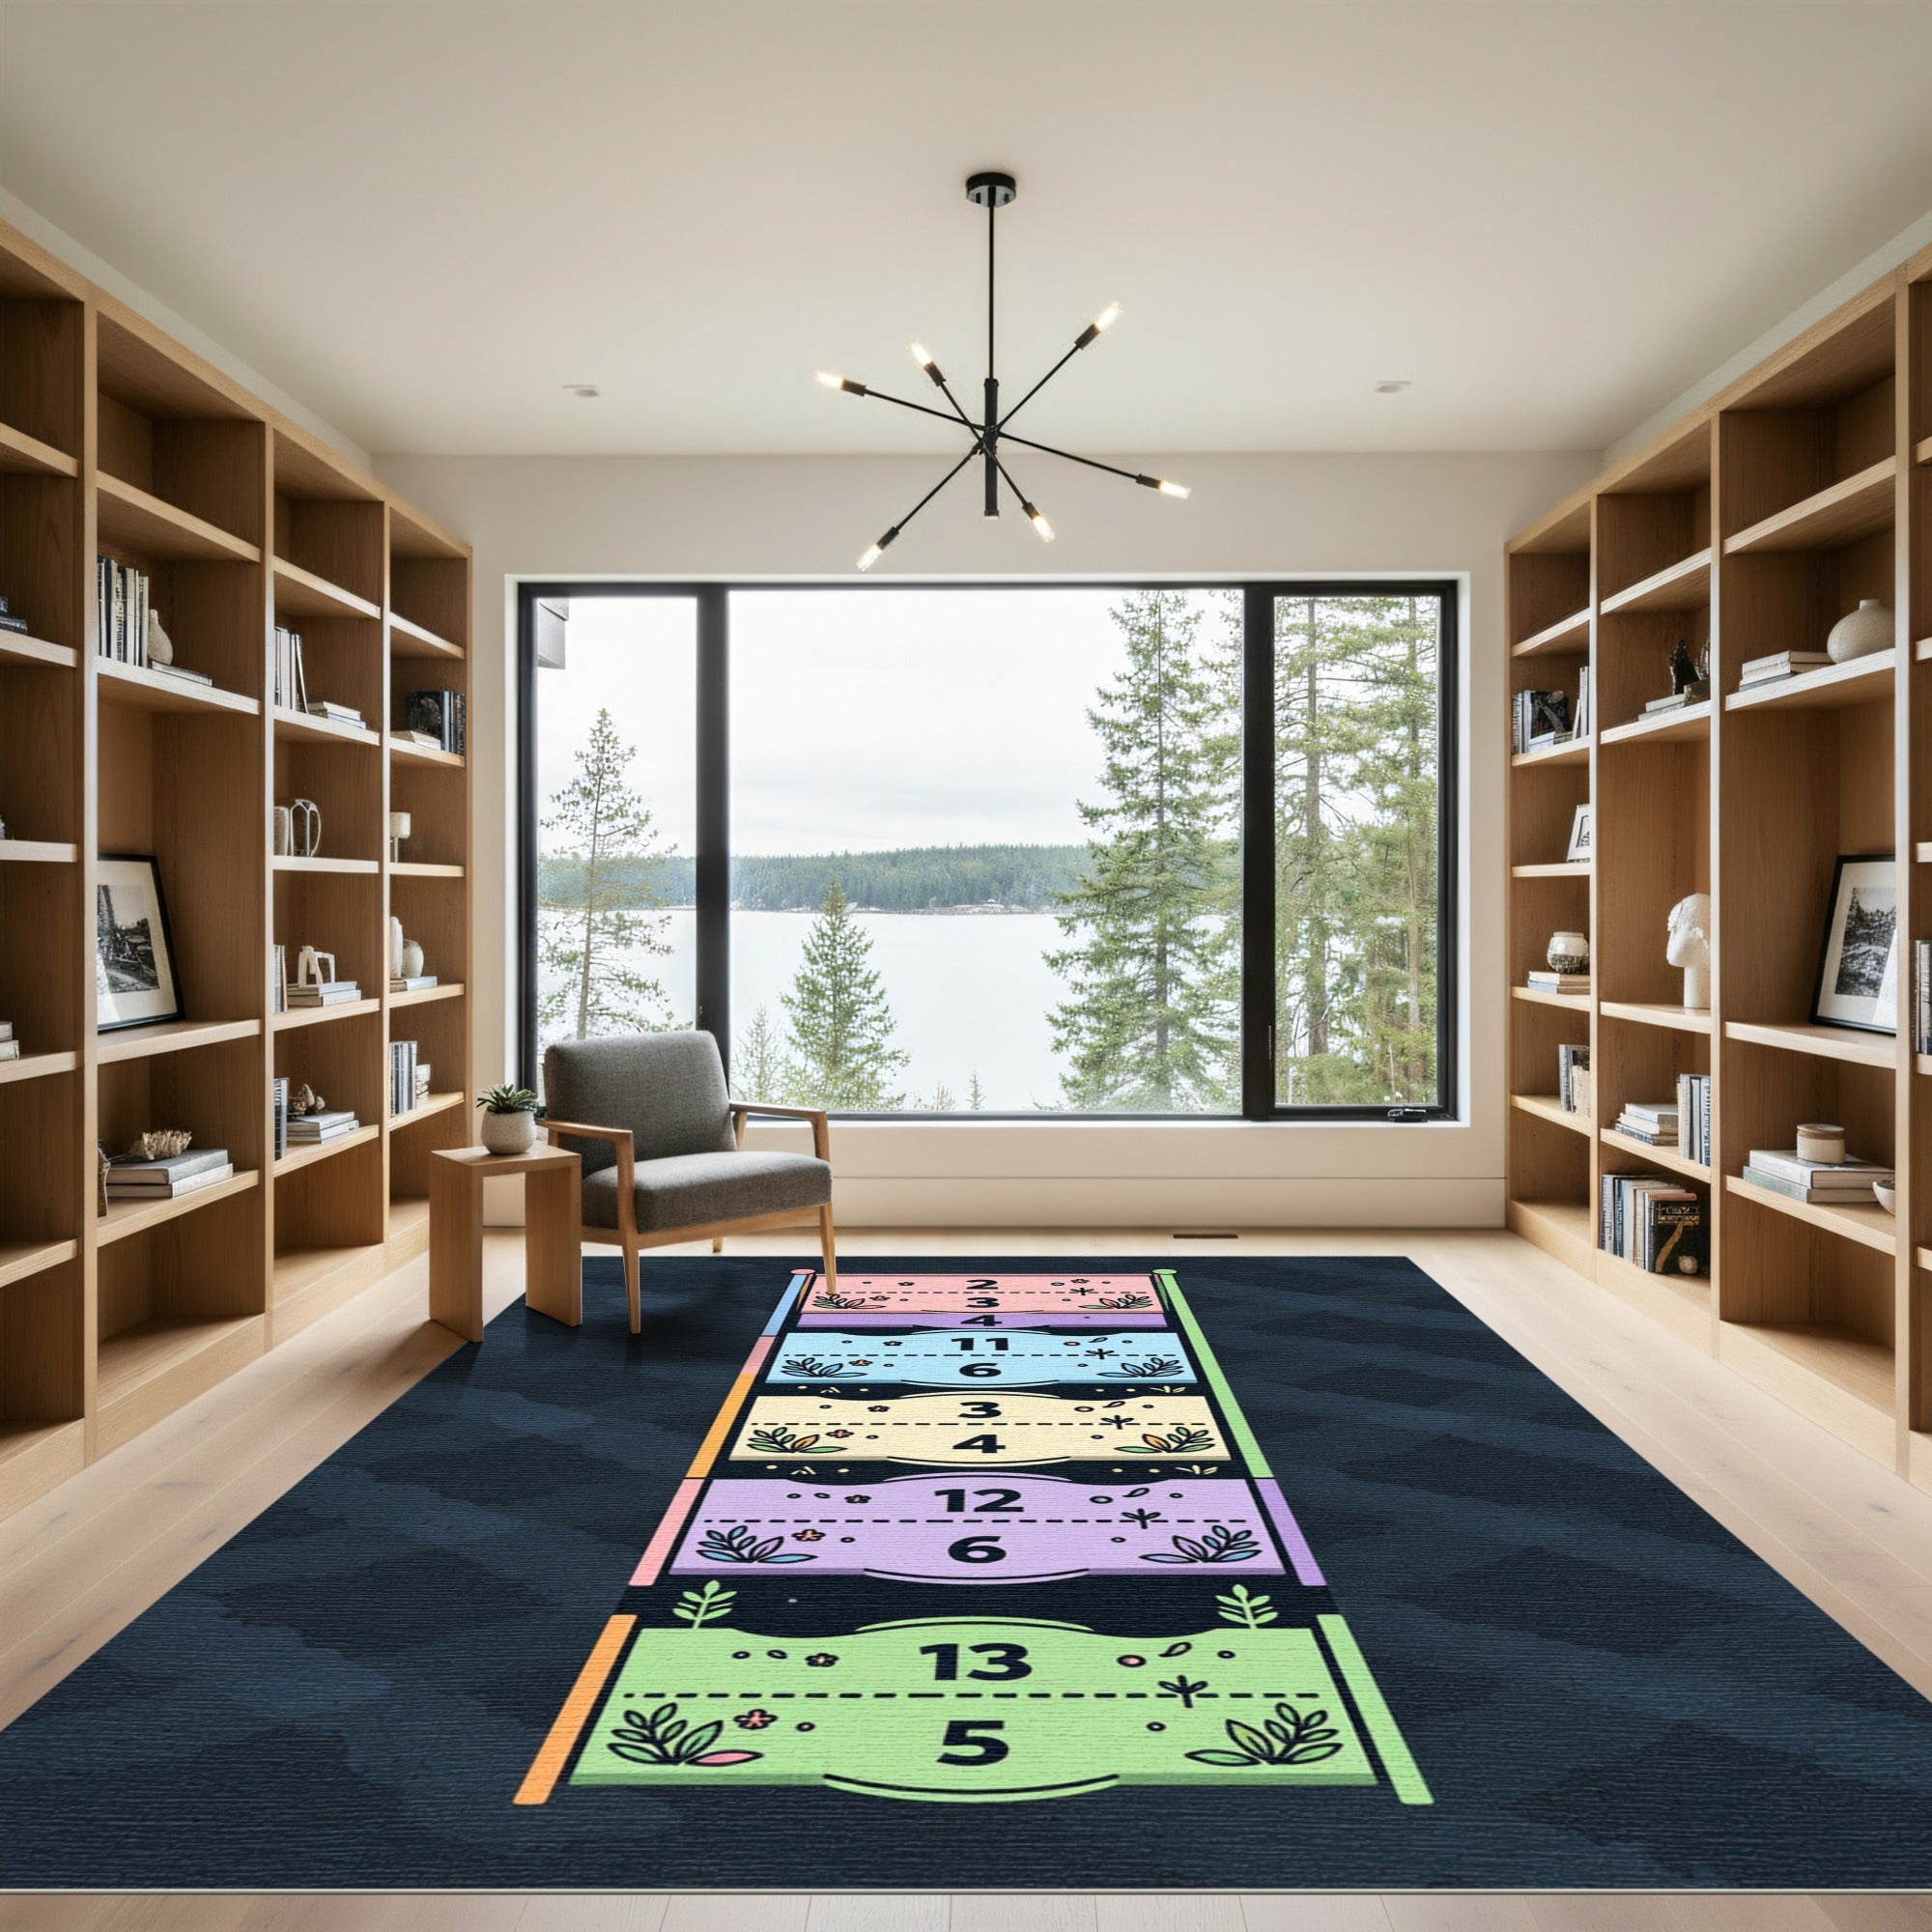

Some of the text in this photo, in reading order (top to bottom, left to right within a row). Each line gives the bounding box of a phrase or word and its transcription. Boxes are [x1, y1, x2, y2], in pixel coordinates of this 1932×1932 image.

[965, 1279, 999, 1290] 2
[965, 1296, 1000, 1309] 3
[960, 1314, 1003, 1327] 4
[951, 1337, 1009, 1351] 11
[958, 1362, 1002, 1378] 6
[958, 1401, 1002, 1419] 3
[952, 1434, 1006, 1454] 4
[934, 1488, 1025, 1513] 12
[948, 1535, 1007, 1564] 6
[919, 1642, 1033, 1682] 13
[936, 1719, 1009, 1767] 5
